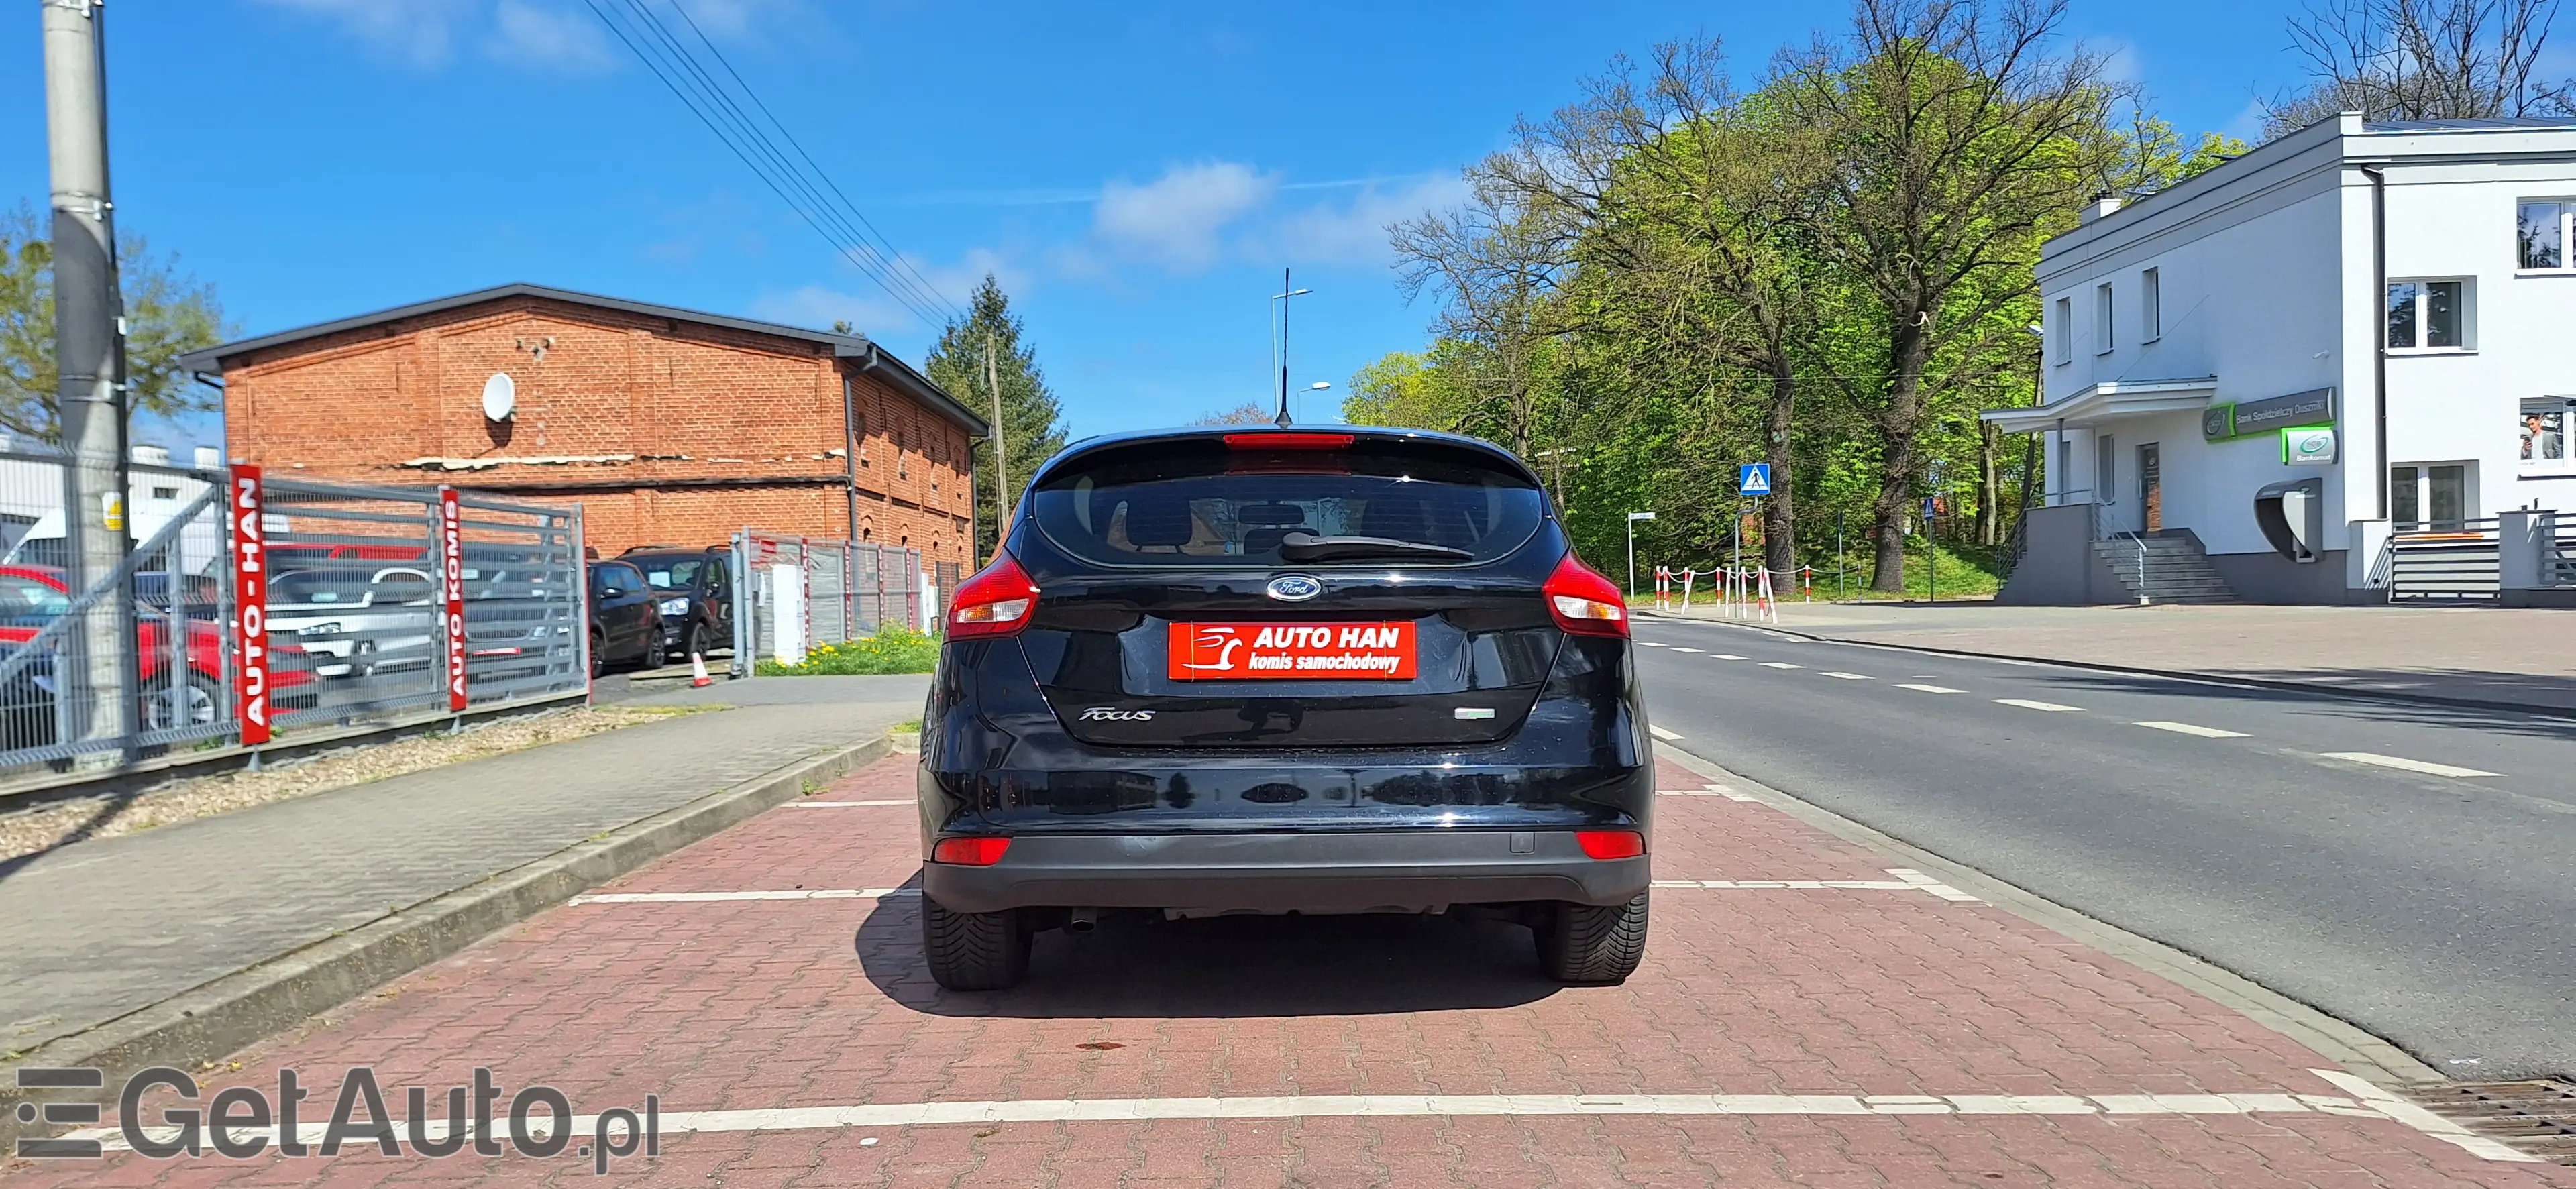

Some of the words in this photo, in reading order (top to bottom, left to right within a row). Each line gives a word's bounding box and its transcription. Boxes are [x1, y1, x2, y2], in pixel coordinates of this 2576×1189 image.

[2237, 414, 2252, 424] Bank
[238, 478, 260, 573] HAN
[445, 500, 461, 601] KOMIS
[1279, 581, 1309, 594] Ford
[451, 614, 465, 696] AUTO
[1248, 652, 1293, 670] komis
[1295, 652, 1401, 674] samochodowy
[1253, 627, 1332, 648] AUTO
[1338, 627, 1399, 648] HAN
[244, 604, 266, 726] AUTO
